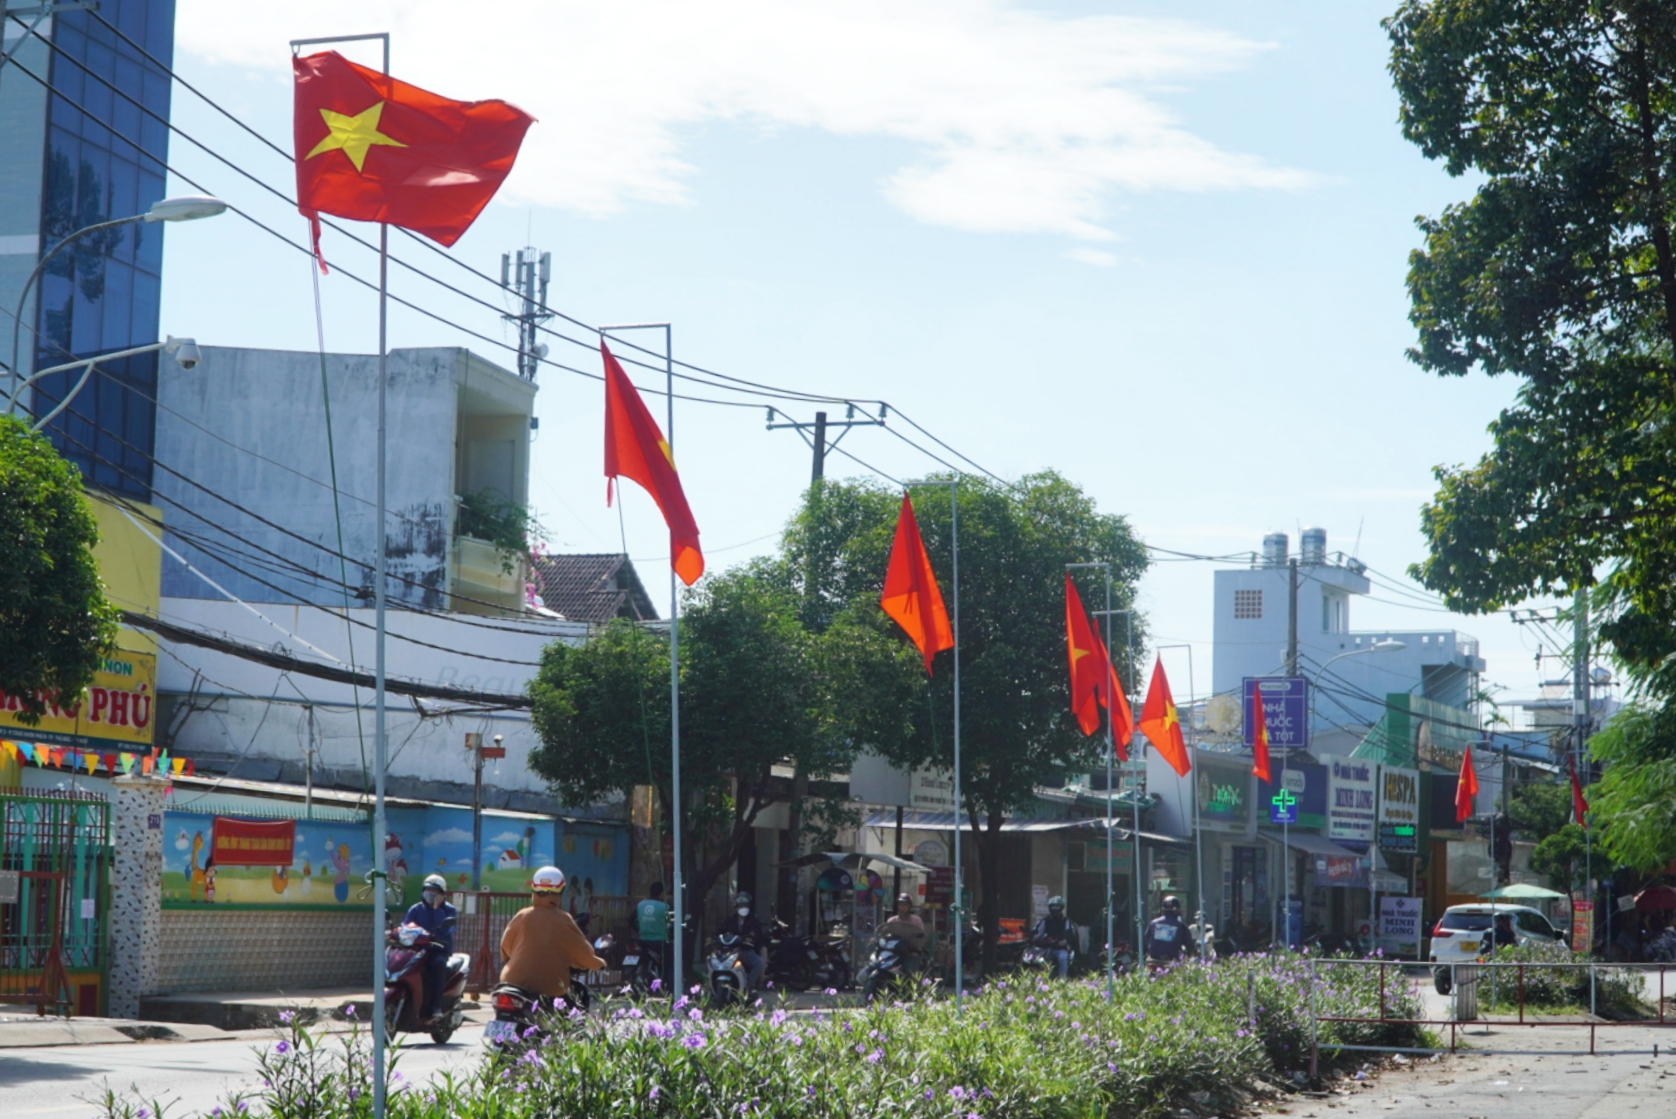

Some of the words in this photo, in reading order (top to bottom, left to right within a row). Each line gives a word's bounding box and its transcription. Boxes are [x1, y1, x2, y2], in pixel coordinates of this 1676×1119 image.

[90, 683, 151, 728] PHÚ
[1334, 788, 1354, 808] MINH
[1355, 790, 1373, 810] LONG
[1397, 909, 1419, 918] THUỐC
[1385, 918, 1415, 927] MINH
[1385, 927, 1415, 935] LONG
